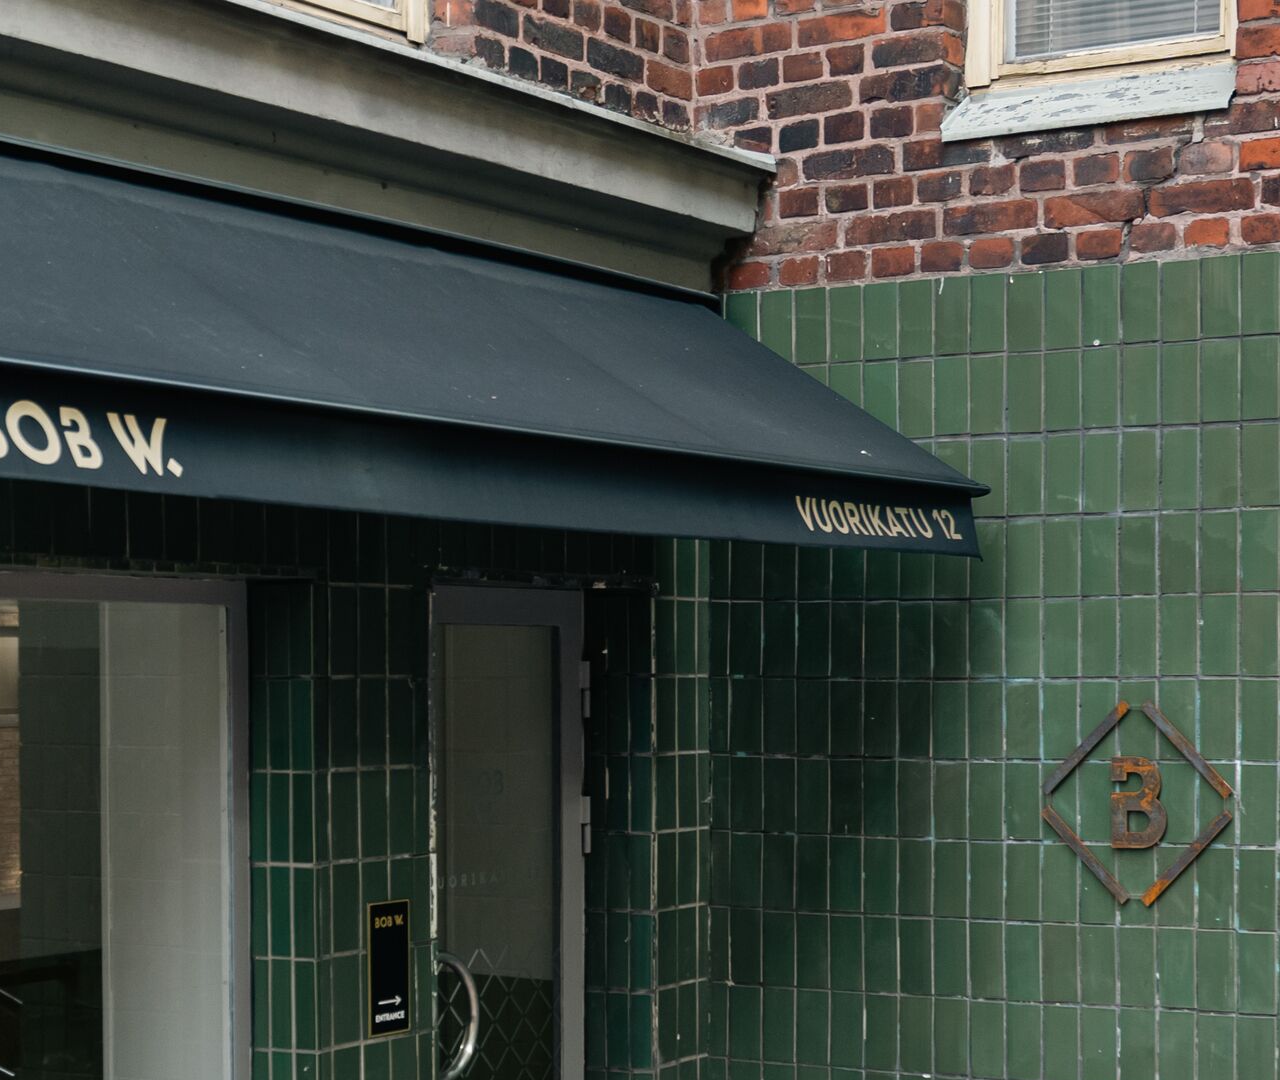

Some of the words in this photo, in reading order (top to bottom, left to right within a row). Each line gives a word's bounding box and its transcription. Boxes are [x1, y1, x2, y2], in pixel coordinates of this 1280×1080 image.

[107, 412, 184, 478] W.
[795, 495, 933, 539] VUORIKATU
[932, 508, 963, 540] 12
[1110, 756, 1168, 849] B
[374, 915, 393, 929] BOB
[375, 1010, 405, 1023] ENTRANCE
